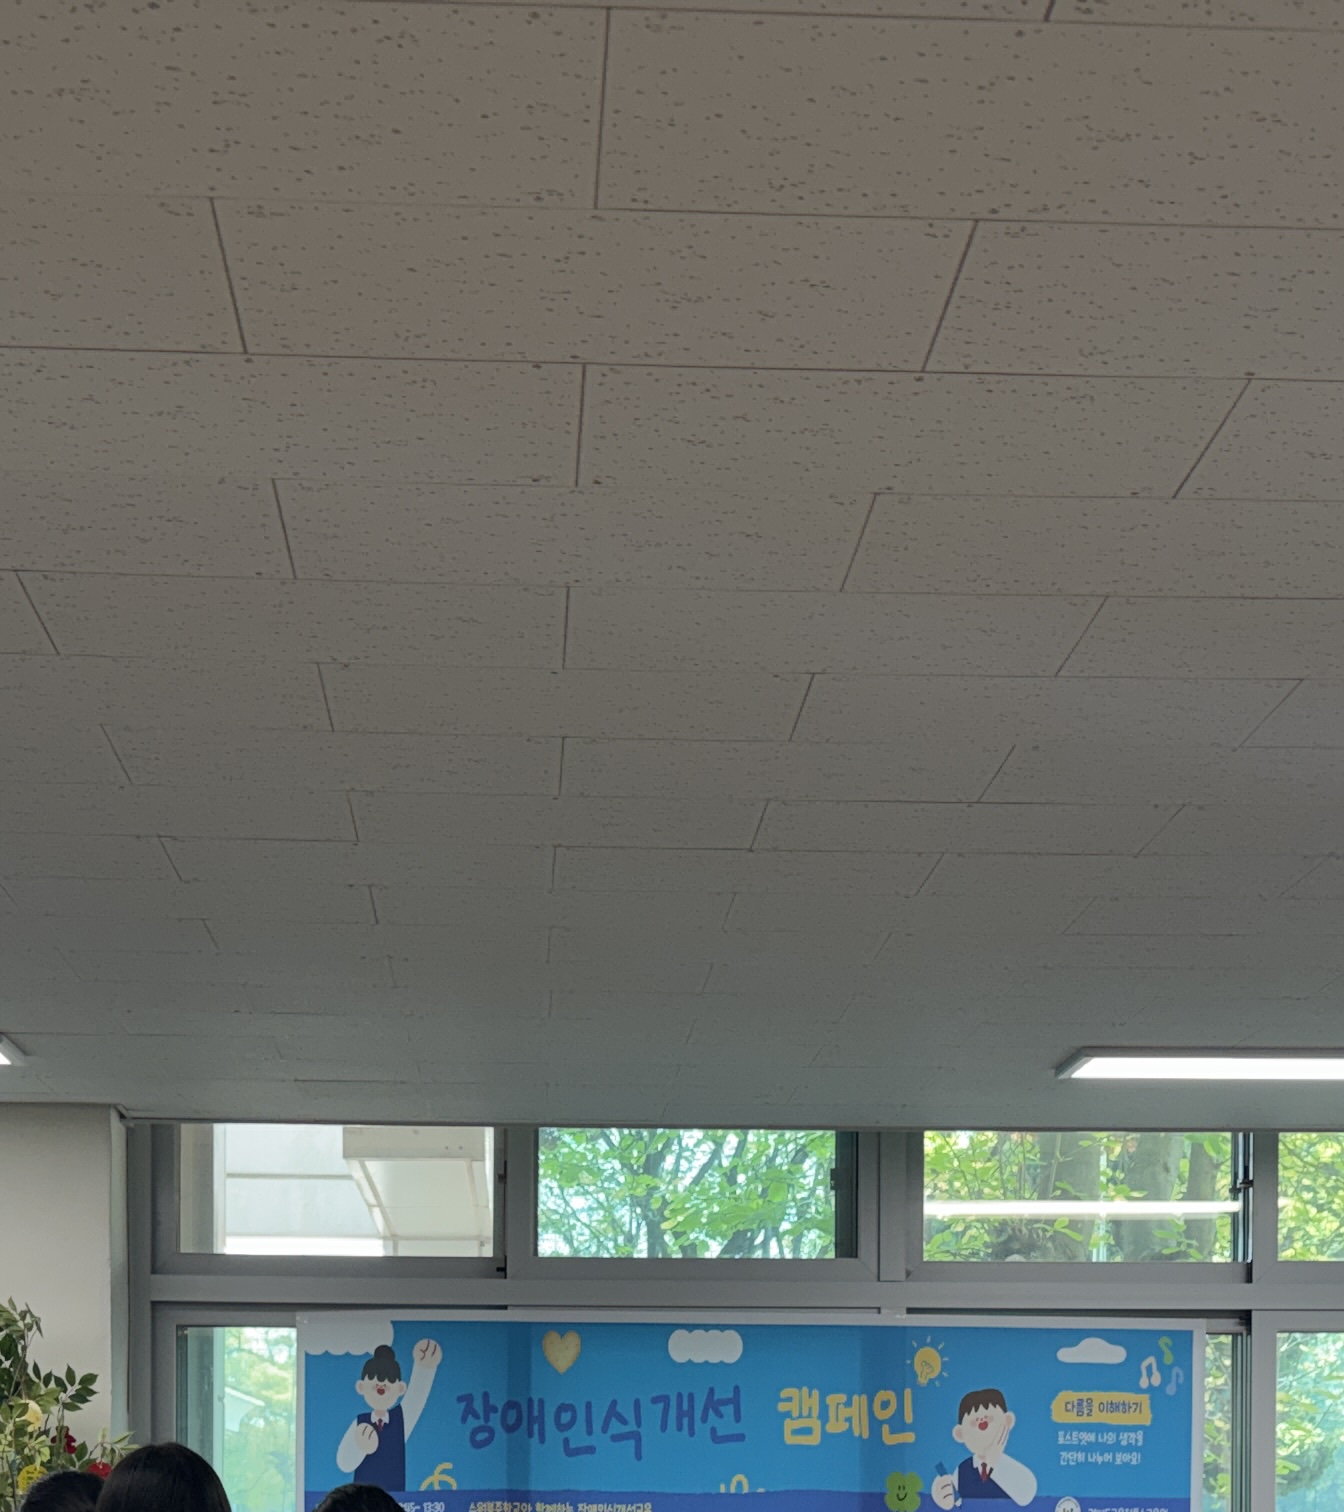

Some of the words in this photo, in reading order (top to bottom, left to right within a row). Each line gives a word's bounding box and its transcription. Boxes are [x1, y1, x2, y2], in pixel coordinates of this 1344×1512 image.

[1064, 1397, 1093, 1417] 다름을
[1098, 1399, 1142, 1414] 이해하기
[460, 1385, 746, 1461] 장애인식개선
[778, 1387, 915, 1445] 캠페인
[1057, 1430, 1096, 1445] 포스트잇에
[1098, 1431, 1116, 1445] 나의
[1118, 1430, 1144, 1446] 생각을
[1059, 1451, 1085, 1465] 간단히
[1087, 1451, 1113, 1465] 나누어
